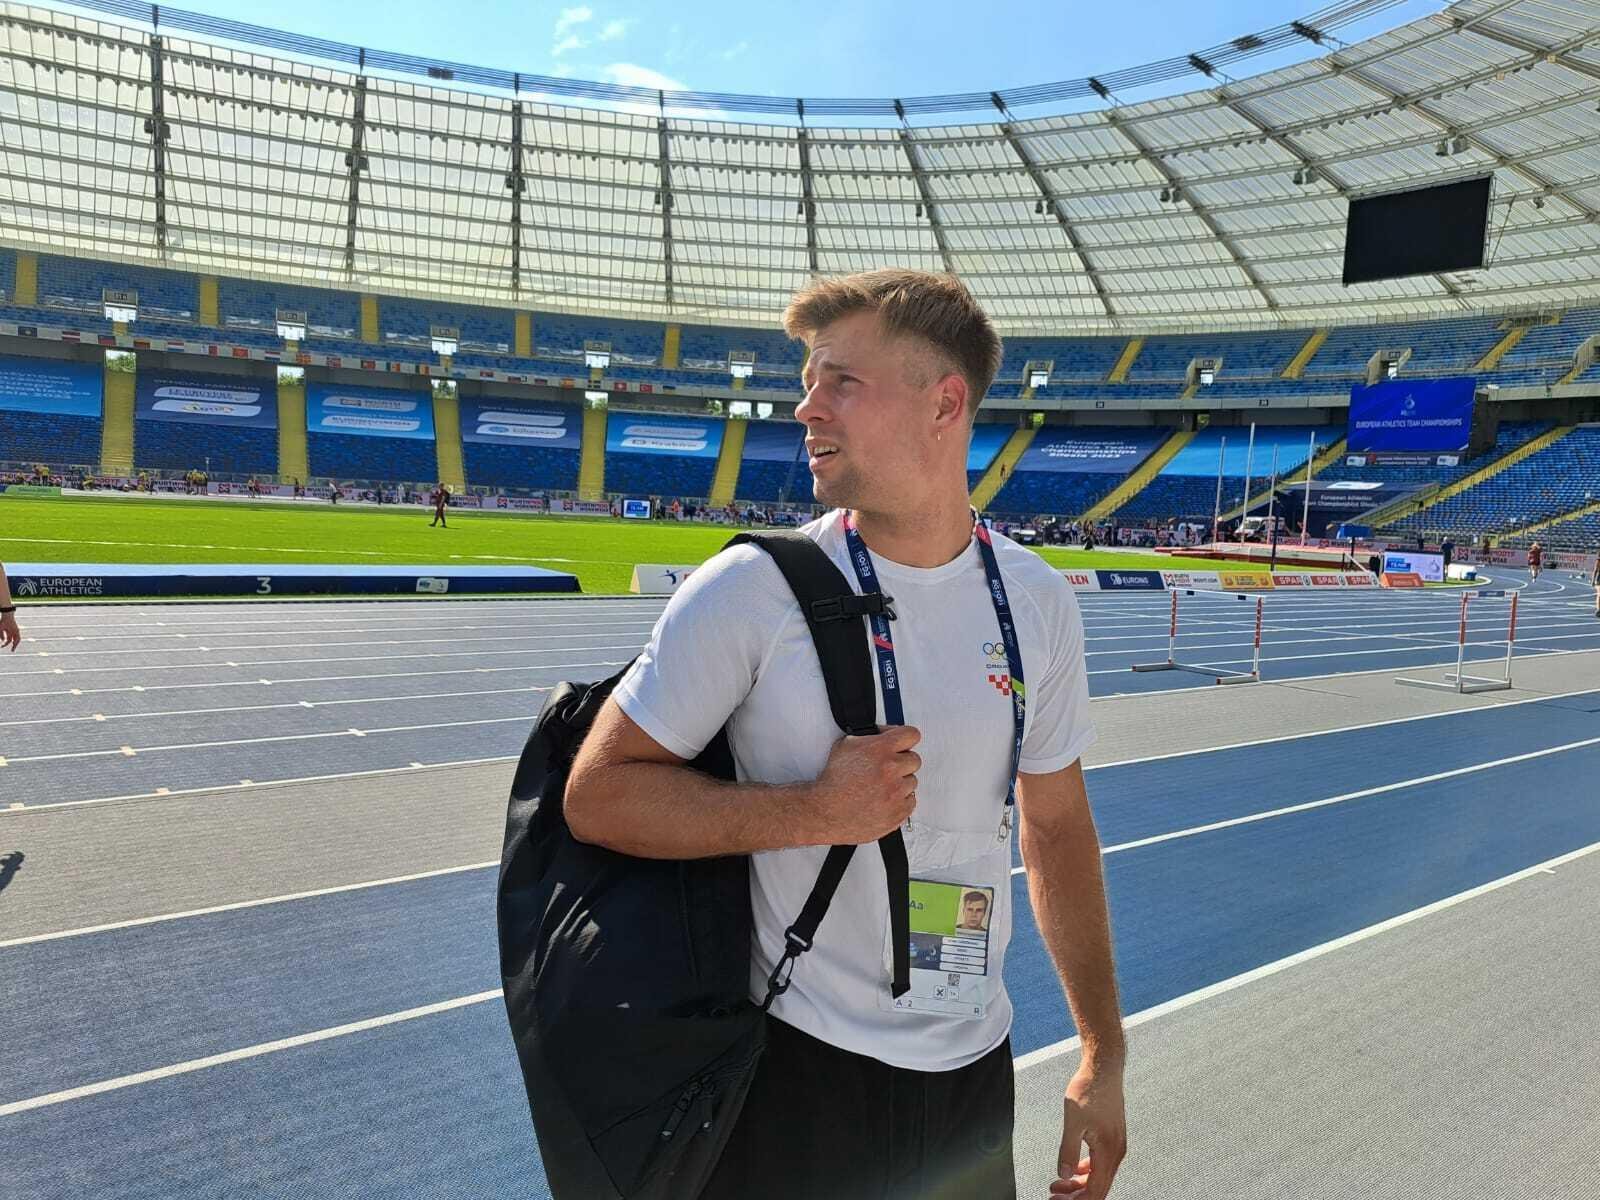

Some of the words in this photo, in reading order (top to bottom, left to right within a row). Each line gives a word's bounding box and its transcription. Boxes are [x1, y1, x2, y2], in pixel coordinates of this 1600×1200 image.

[40, 578, 102, 586] EUROPEAN
[1280, 576, 1304, 585] SPAR
[1316, 576, 1341, 585] SPAR
[1350, 576, 1372, 585] SPAR
[256, 577, 272, 594] 3
[40, 587, 103, 595] ATHLETICS
[907, 1000, 913, 1008] 2
